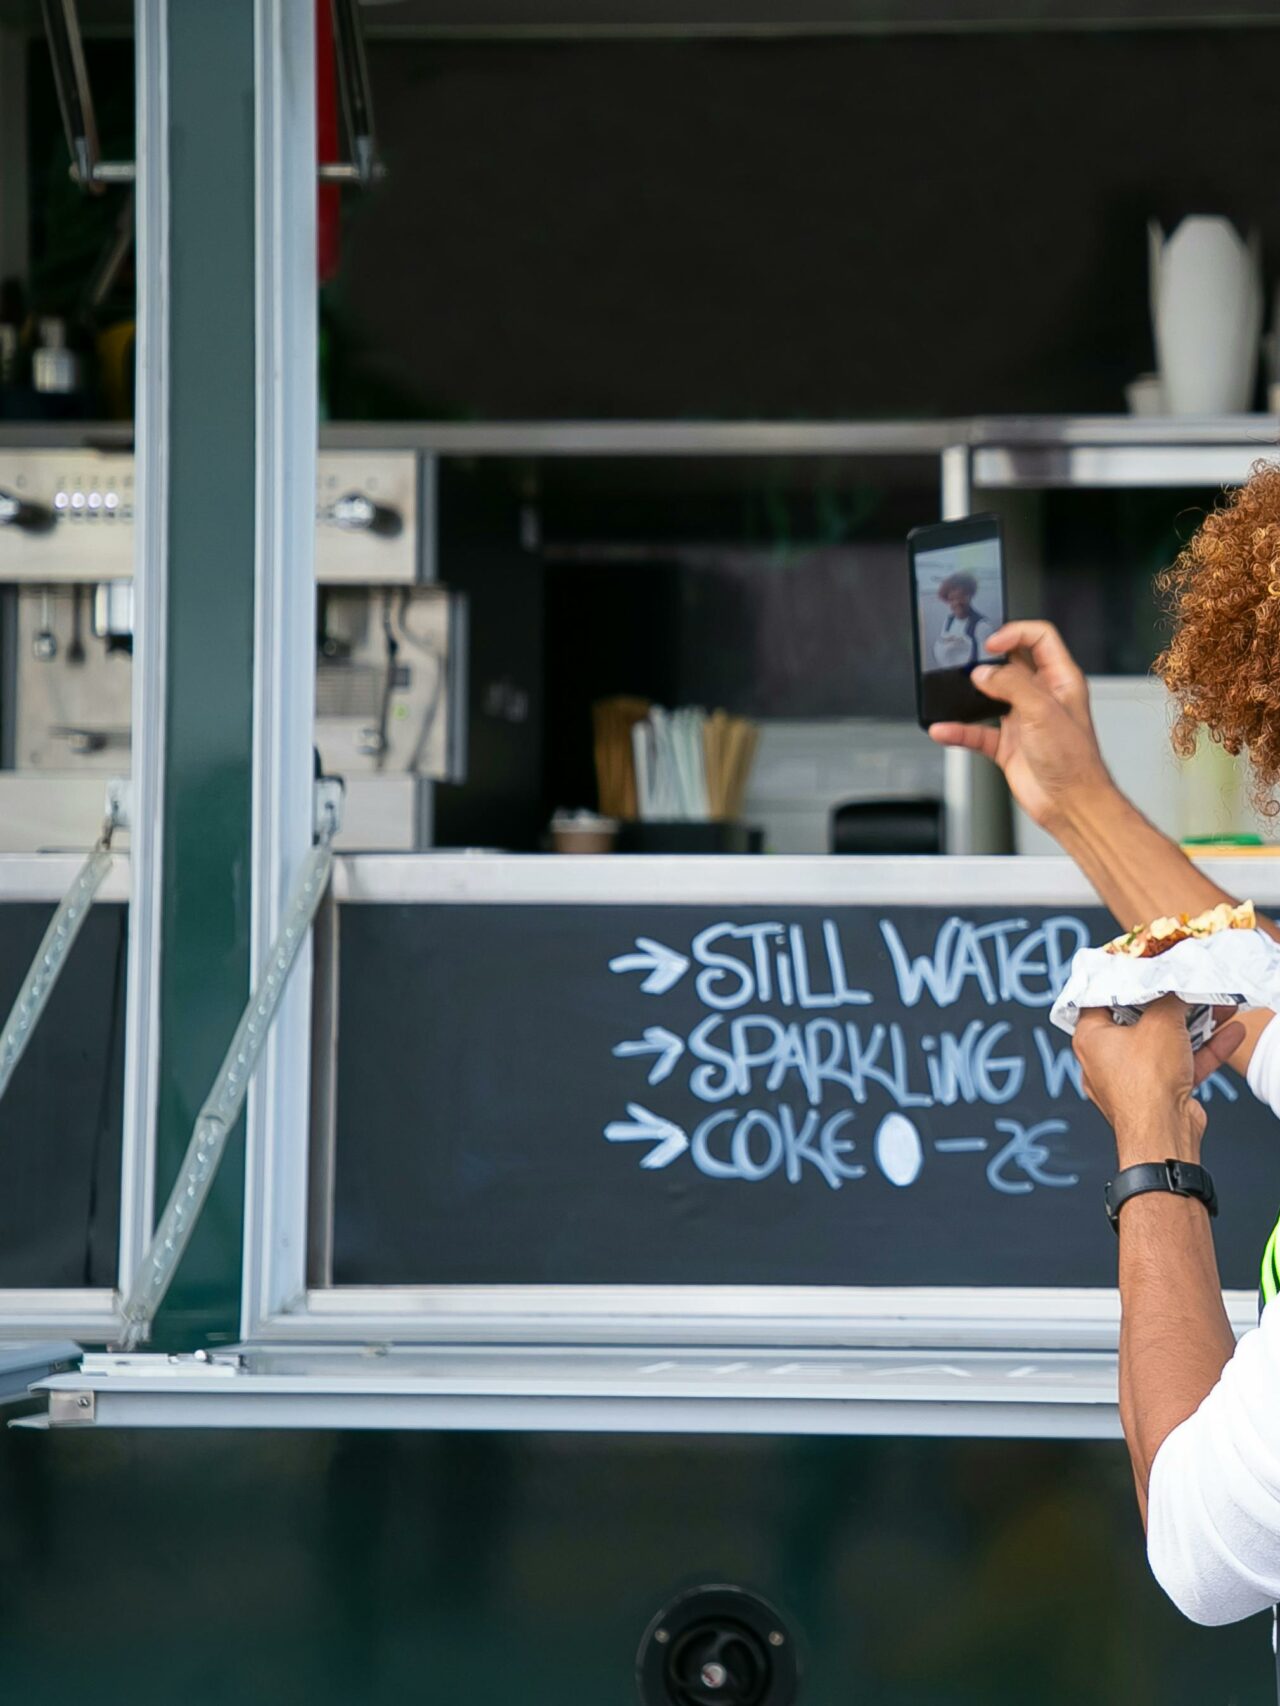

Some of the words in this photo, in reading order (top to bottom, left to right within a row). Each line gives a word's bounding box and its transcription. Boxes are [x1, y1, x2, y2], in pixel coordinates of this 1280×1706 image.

[691, 920, 874, 1011] STiLL
[687, 1012, 1027, 1108] SPARKLiNG
[691, 1103, 868, 1190] COKE
[636, 1359, 1118, 1379] HEAL
